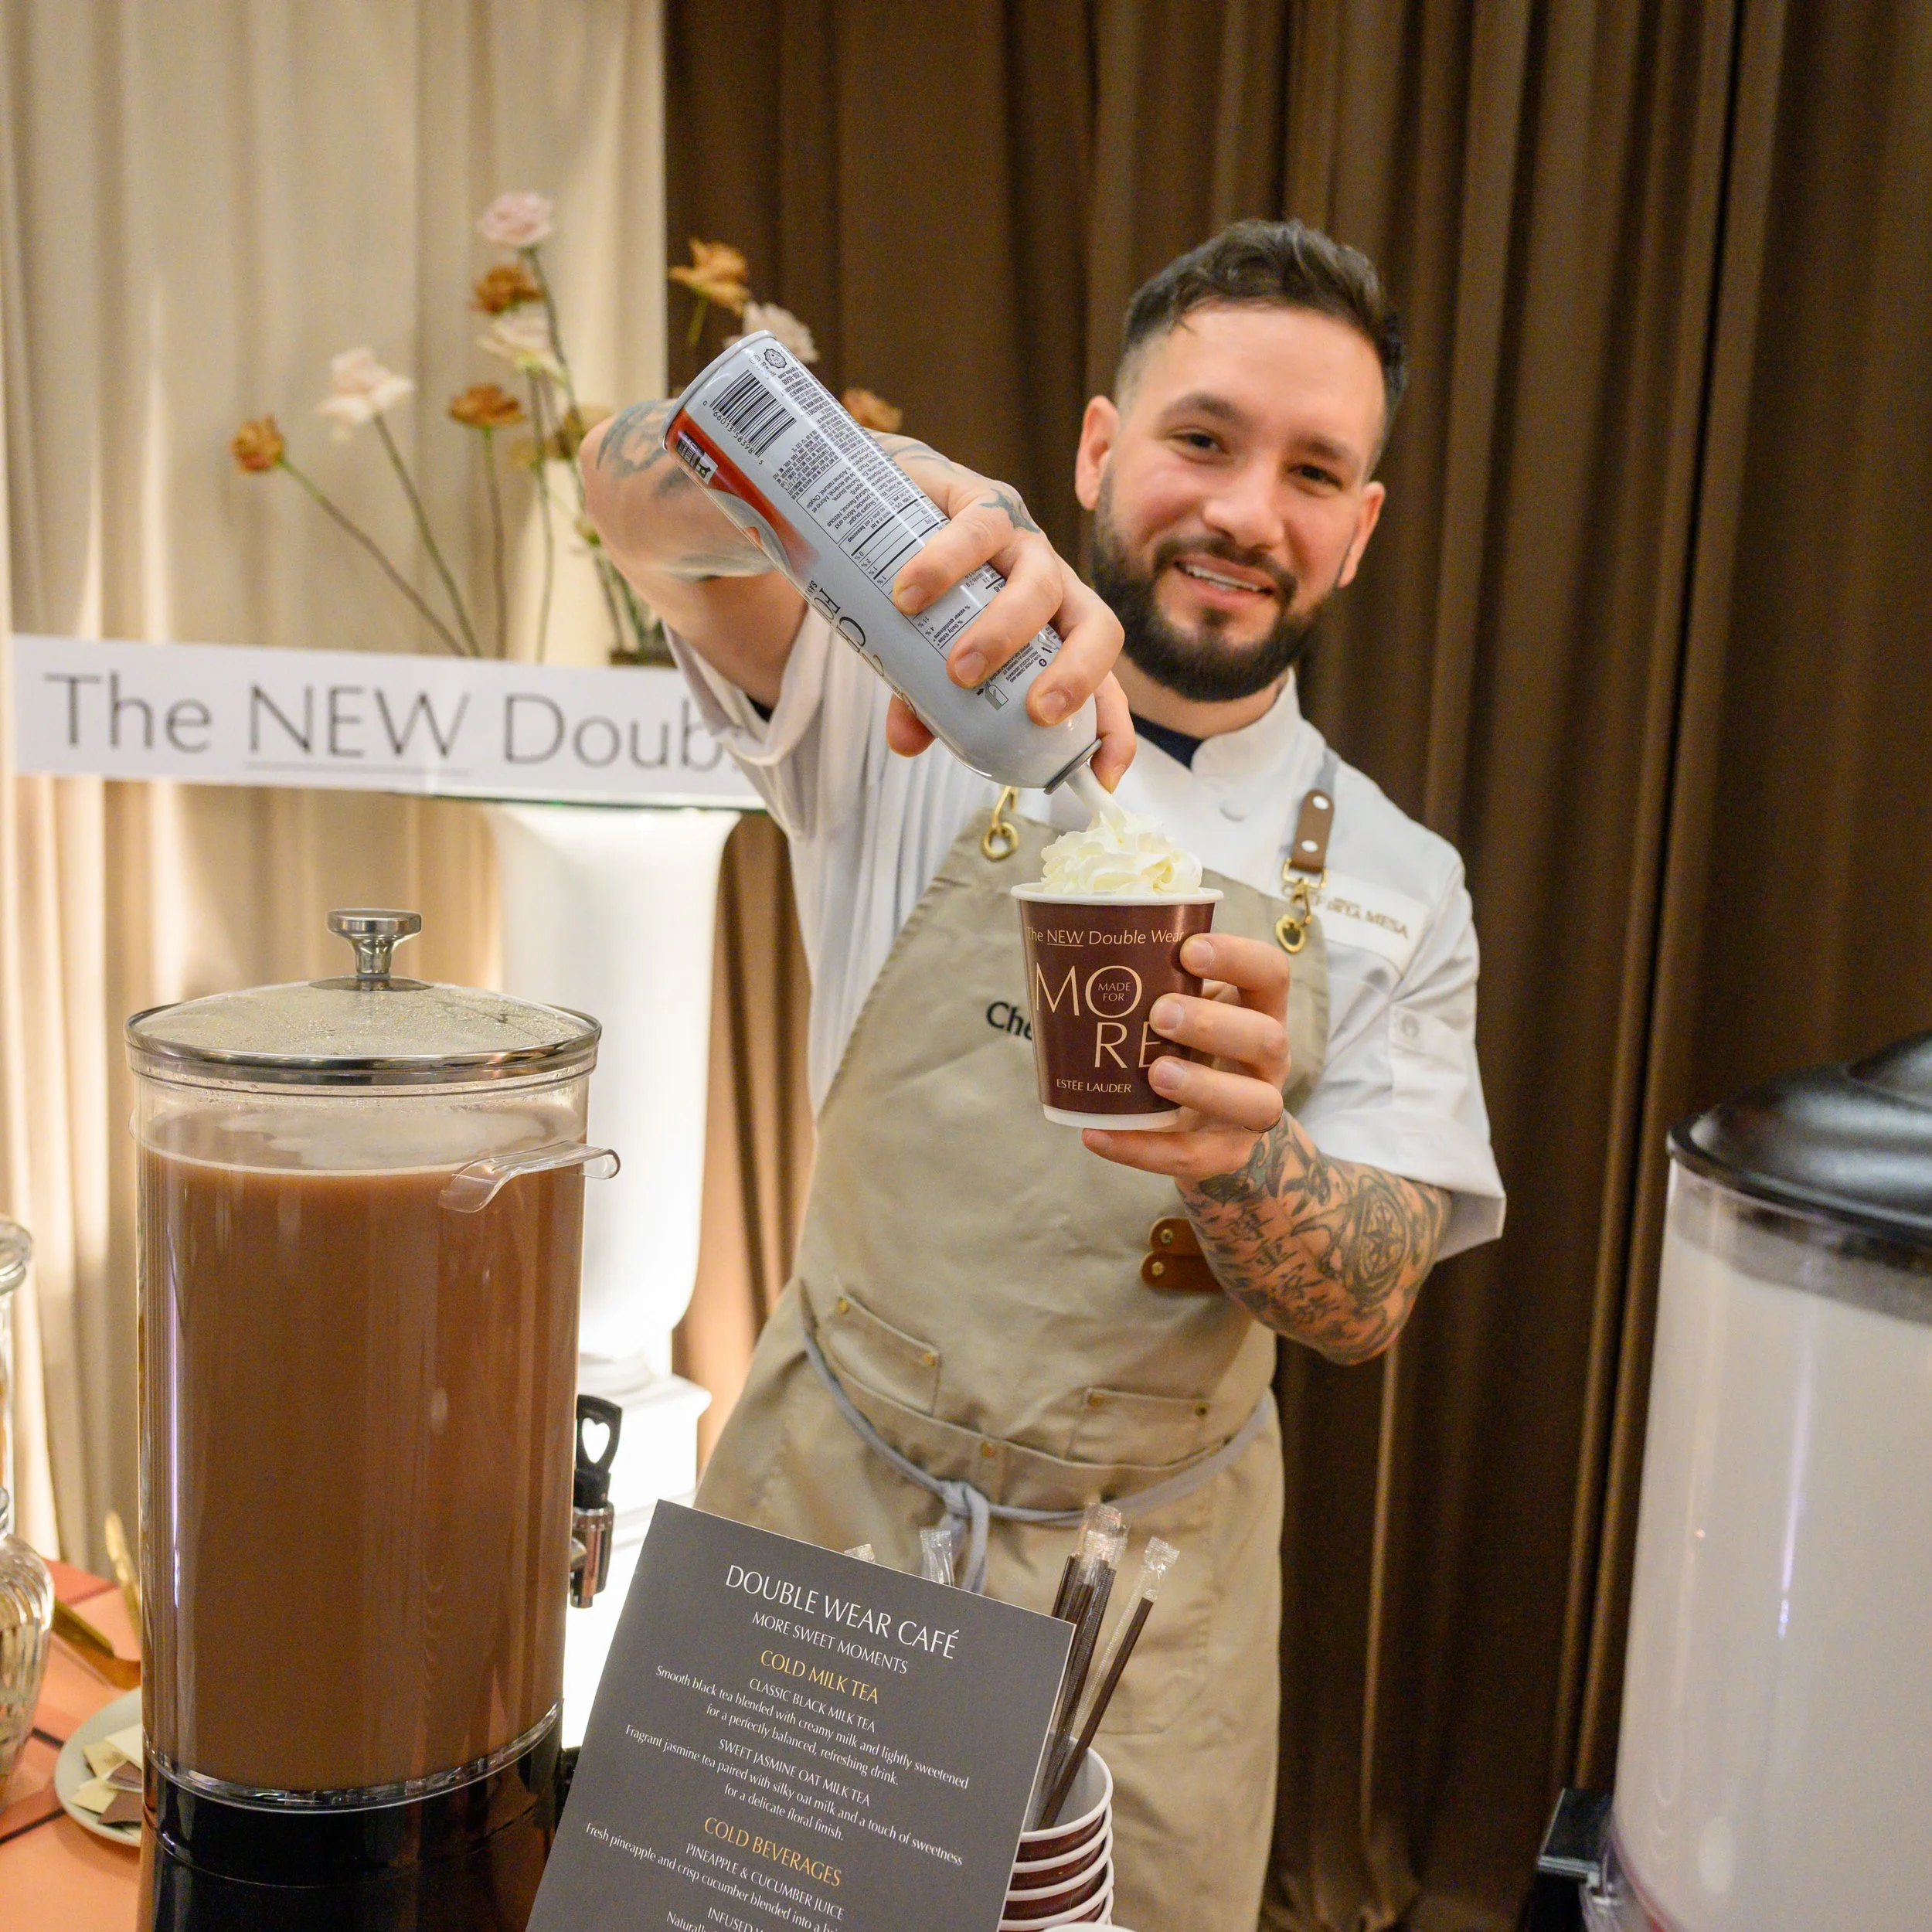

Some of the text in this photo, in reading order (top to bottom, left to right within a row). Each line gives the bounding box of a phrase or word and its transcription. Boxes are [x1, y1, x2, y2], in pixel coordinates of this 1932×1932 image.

[712, 410, 734, 434] 66013
[732, 431, 754, 454] 58398
[832, 468, 849, 484] Arôme
[844, 476, 860, 491] Sucres
[854, 486, 870, 501] Natural
[804, 493, 821, 509] Oxyde
[815, 495, 830, 509] Mono
[825, 511, 842, 527] Nitrous
[833, 493, 871, 529] powder, Mono and
[859, 498, 876, 515] Sugars
[846, 525, 866, 543] beaucoup
[811, 587, 840, 624] FO
[953, 608, 966, 620] valeur
[835, 616, 868, 654] CR
[947, 622, 959, 634] Daily
[46, 672, 725, 771] The NEW Doub
[1026, 927, 1185, 944] The NEW Double Wear
[1036, 962, 1142, 1019] MO
[1098, 982, 1131, 992] MADE
[1103, 993, 1124, 1002] FOR
[1087, 1083, 1131, 1093] LAUDER
[725, 1564, 959, 1659] DOUBLE WEAR CAFÉ
[751, 1611, 908, 1674] MORE SWEET MOMENTS
[760, 1649, 877, 1704] COLD MILK TEA
[749, 1678, 874, 1733] CLASSIC BLACK MILK TEA
[655, 1665, 969, 1789] Smooth black tea blended with creamy milk and lightly sweetened
[706, 1702, 720, 1716] for
[728, 1714, 770, 1738] perfectly
[771, 1726, 817, 1756] balanced,
[820, 1749, 868, 1777] refreshing
[870, 1764, 898, 1785] drink.
[718, 1738, 869, 1807] SWEET JASMINE OAT MILK TEA
[625, 1724, 962, 1865] Fragrant jasmine tea paired with silky oat milk and a touch of sweetness
[724, 1782, 843, 1841] for a delicate floral finish.
[704, 1817, 842, 1886] COLD BEVERAGES
[585, 1822, 609, 1841] Fresh
[608, 1835, 655, 1861] pineapple
[657, 1855, 676, 1869] and
[677, 1864, 699, 1882] crisp
[701, 1875, 749, 1901] cucumber
[750, 1891, 791, 1920] blended
[791, 1910, 811, 1929] into
[813, 1923, 820, 1932] a
[685, 1842, 844, 1920] PINEAPPLE & CUCUMBER JUICE
[666, 1910, 706, 1932] Naturall
[707, 1906, 753, 1932] INFUSED
